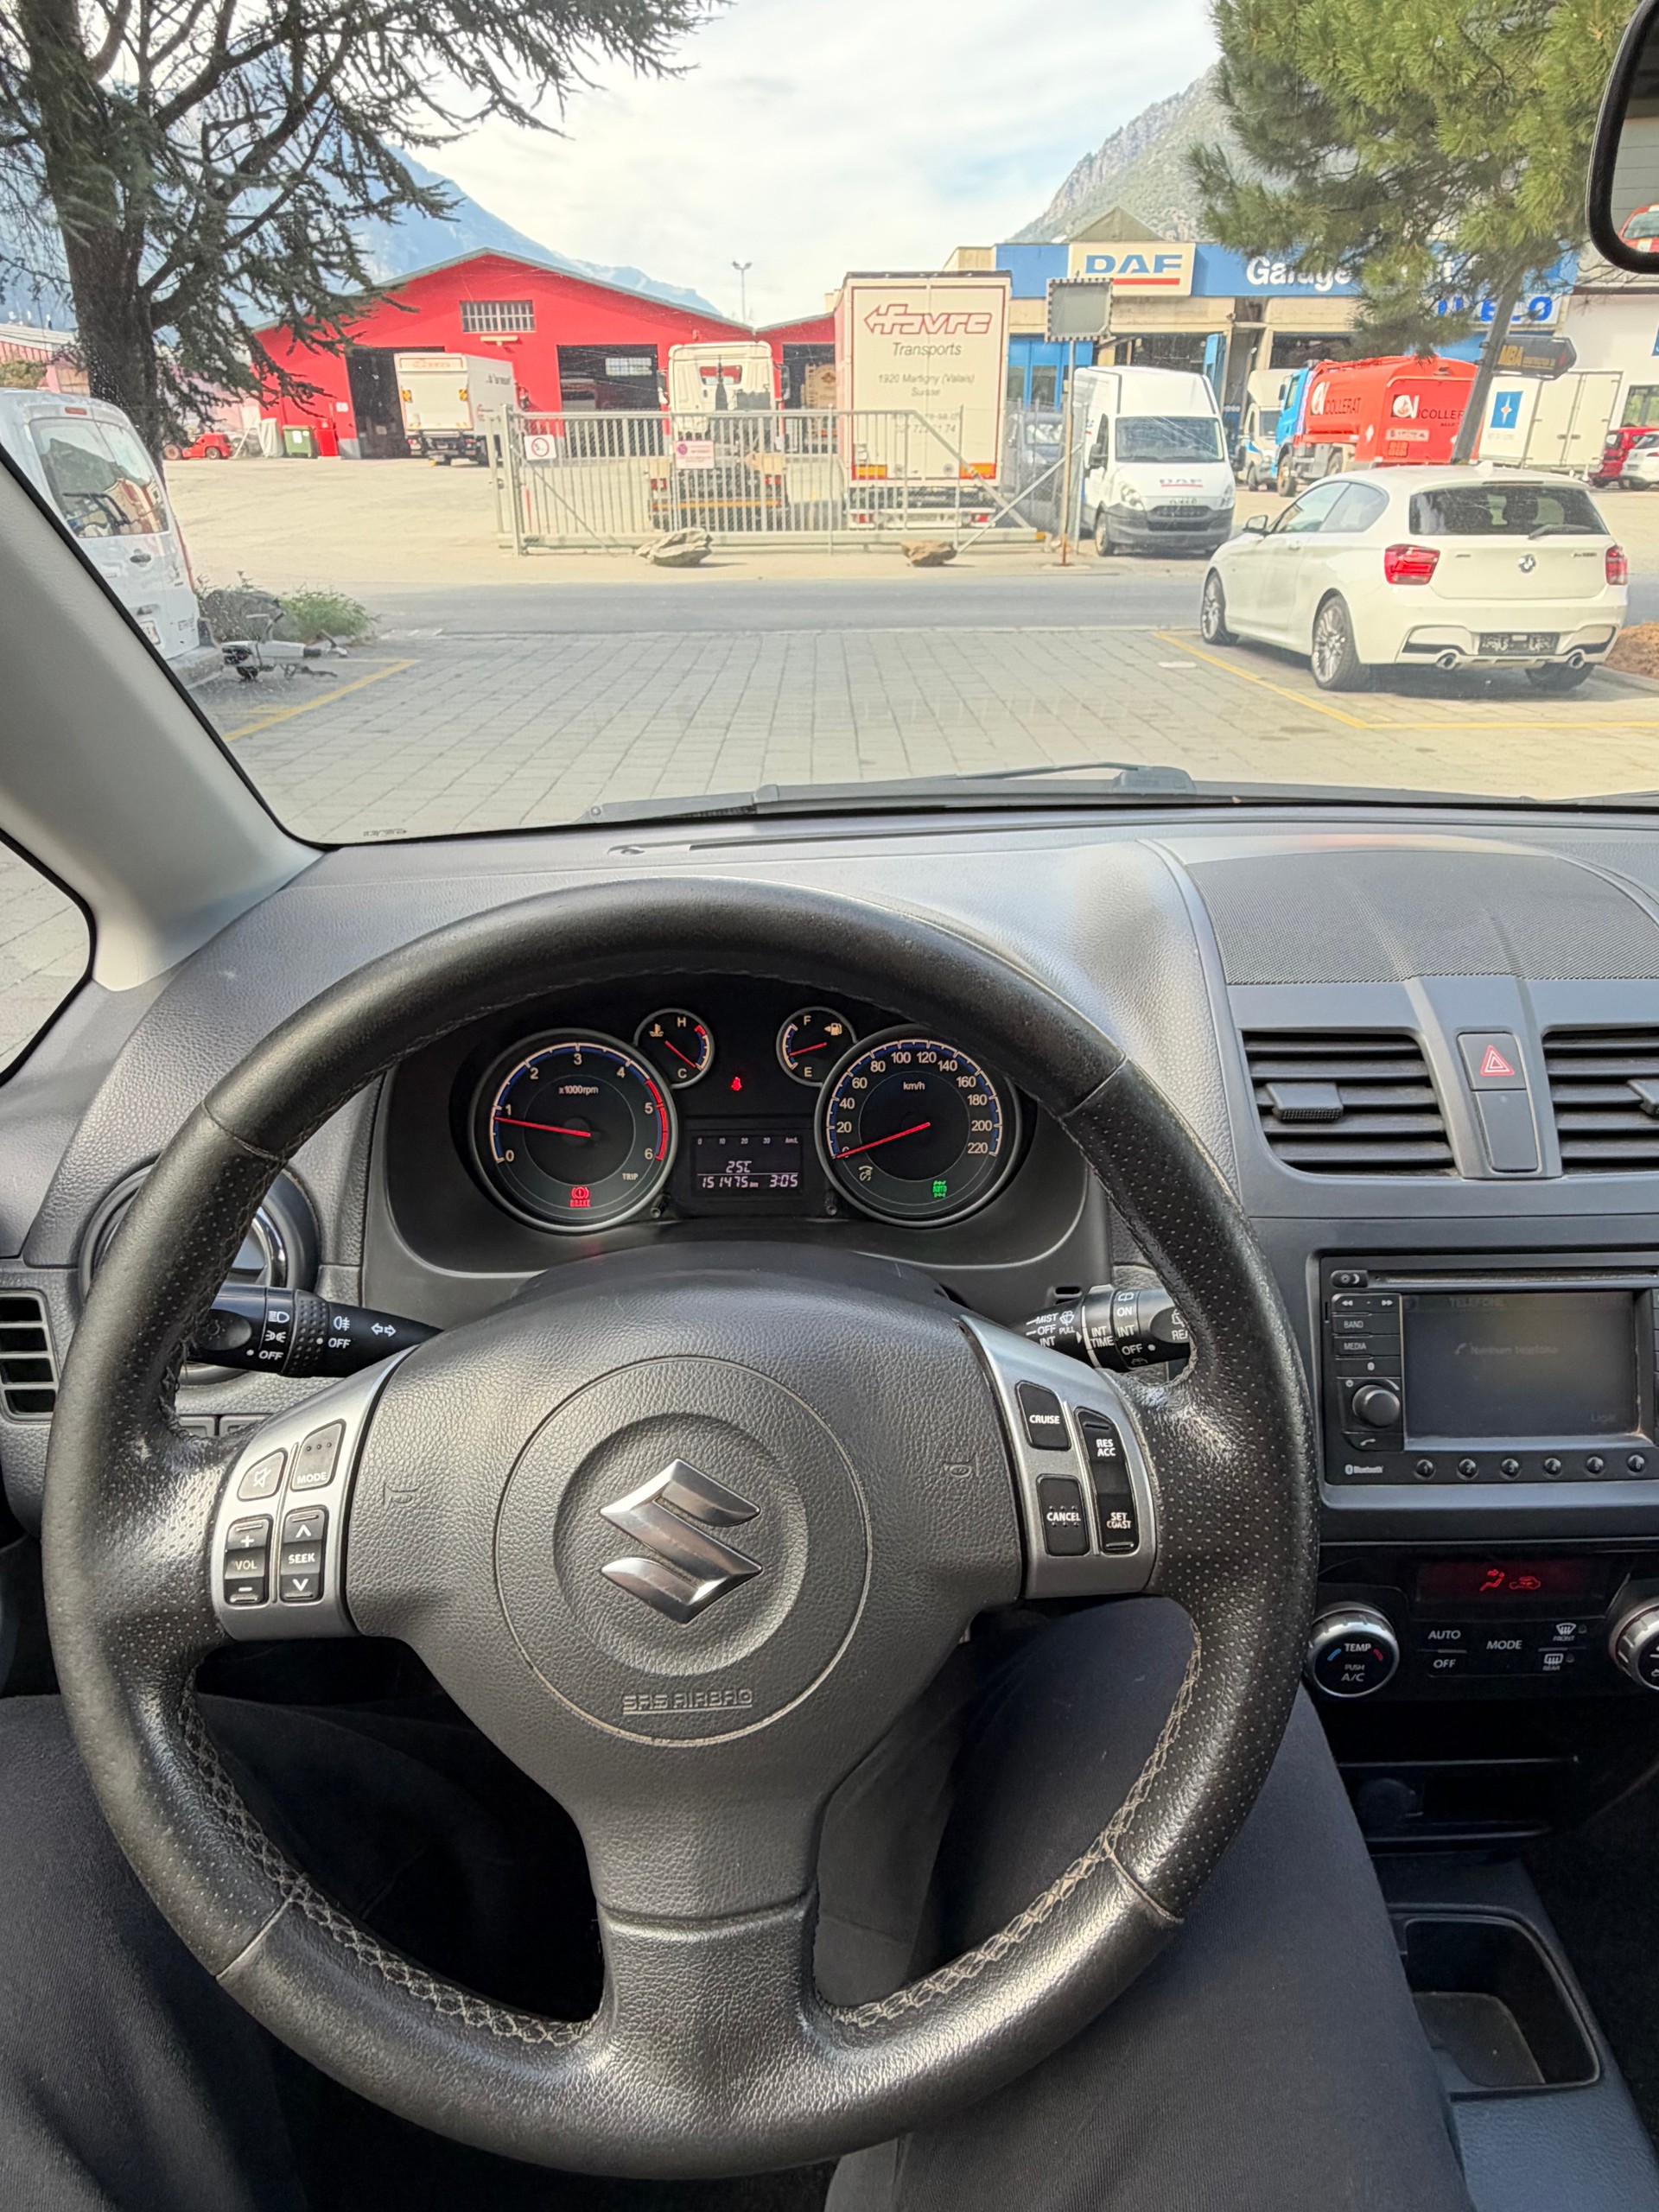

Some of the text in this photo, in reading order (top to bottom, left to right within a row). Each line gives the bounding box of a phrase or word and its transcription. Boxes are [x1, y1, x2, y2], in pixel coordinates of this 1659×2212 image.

[1084, 255, 1183, 274] DAF
[893, 342, 962, 356] Transports
[878, 374, 899, 383] 1920
[902, 374, 939, 385] Martigny
[677, 1017, 686, 1027] H
[804, 1015, 811, 1025] F
[574, 1053, 582, 1065] 3
[891, 1052, 911, 1064] 100
[917, 1052, 937, 1063] 120
[870, 1062, 886, 1072] 80
[938, 1060, 957, 1071] 140
[531, 1068, 538, 1079] 2
[617, 1067, 626, 1077] 4
[678, 1069, 687, 1078] C
[804, 1067, 811, 1077] E
[852, 1077, 868, 1089] 60
[903, 1082, 925, 1090] km/h
[957, 1077, 976, 1088] 160
[840, 1098, 855, 1109] 40
[968, 1095, 988, 1106] 180
[505, 1105, 512, 1115] 1
[645, 1103, 653, 1114] 5
[836, 1122, 852, 1133] 20
[971, 1120, 992, 1131] 200
[968, 1143, 988, 1154] 220
[505, 1151, 514, 1161] 0
[645, 1149, 653, 1160] 6
[769, 1174, 798, 1188] 3:05
[1116, 1306, 1132, 1317] ON
[1036, 1313, 1057, 1324] MIST
[1037, 1324, 1056, 1334] OFF
[1058, 1325, 1075, 1335] PULL
[1344, 1320, 1363, 1329] BAND
[1091, 1325, 1108, 1337] INT
[1117, 1325, 1135, 1338] INT
[328, 1338, 351, 1350] OFF
[1039, 1336, 1056, 1347] INT
[1092, 1336, 1114, 1348] TIME
[1344, 1341, 1367, 1351] MEDIA
[259, 1350, 283, 1360] OFF
[1122, 1344, 1143, 1356] OFF
[1029, 1414, 1060, 1425] CRUISE
[1096, 1439, 1114, 1448] RES
[1097, 1446, 1116, 1457] ACC
[297, 1471, 327, 1484] MODE
[1046, 1512, 1081, 1522] CANCEL
[1110, 1512, 1128, 1522] SET
[1107, 1521, 1131, 1529] COAST
[289, 1552, 315, 1565] SEEK
[235, 1559, 257, 1571] VOL
[1428, 1630, 1461, 1640] AUTO
[1344, 1643, 1371, 1652] TEMP
[1486, 1640, 1522, 1650] MODE
[1433, 1659, 1457, 1669] OFF
[1341, 1672, 1365, 1682] A/C
